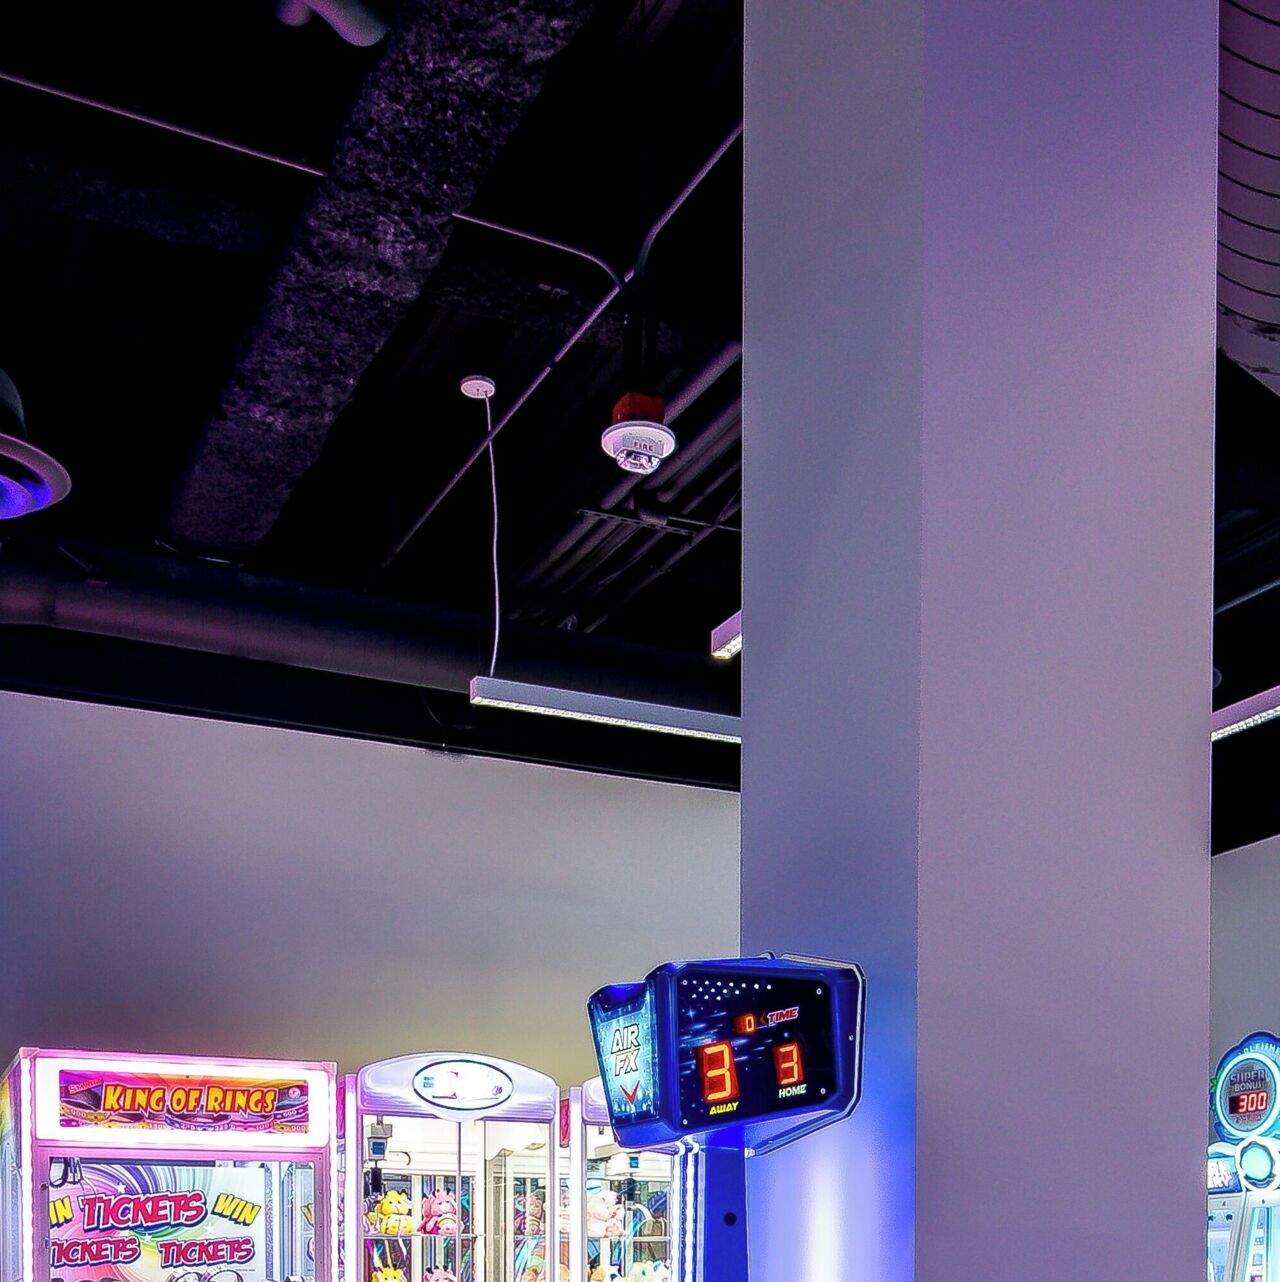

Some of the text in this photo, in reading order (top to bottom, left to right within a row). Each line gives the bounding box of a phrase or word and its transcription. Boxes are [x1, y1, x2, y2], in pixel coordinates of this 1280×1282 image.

[767, 1006, 799, 1025] TIME
[611, 1023, 640, 1054] AIR
[614, 1048, 641, 1077] FX
[703, 1044, 732, 1101] 3
[779, 1045, 799, 1084] 3
[1230, 1069, 1266, 1083] SUPER
[1234, 1081, 1264, 1092] BONUS
[170, 1087, 206, 1113] OF
[778, 1084, 807, 1099] HOME
[1239, 1092, 1267, 1112] 300
[709, 1101, 739, 1116] AWAY
[49, 1191, 260, 1232] IN TICKETS WIN
[157, 1236, 255, 1268] TICKETS
